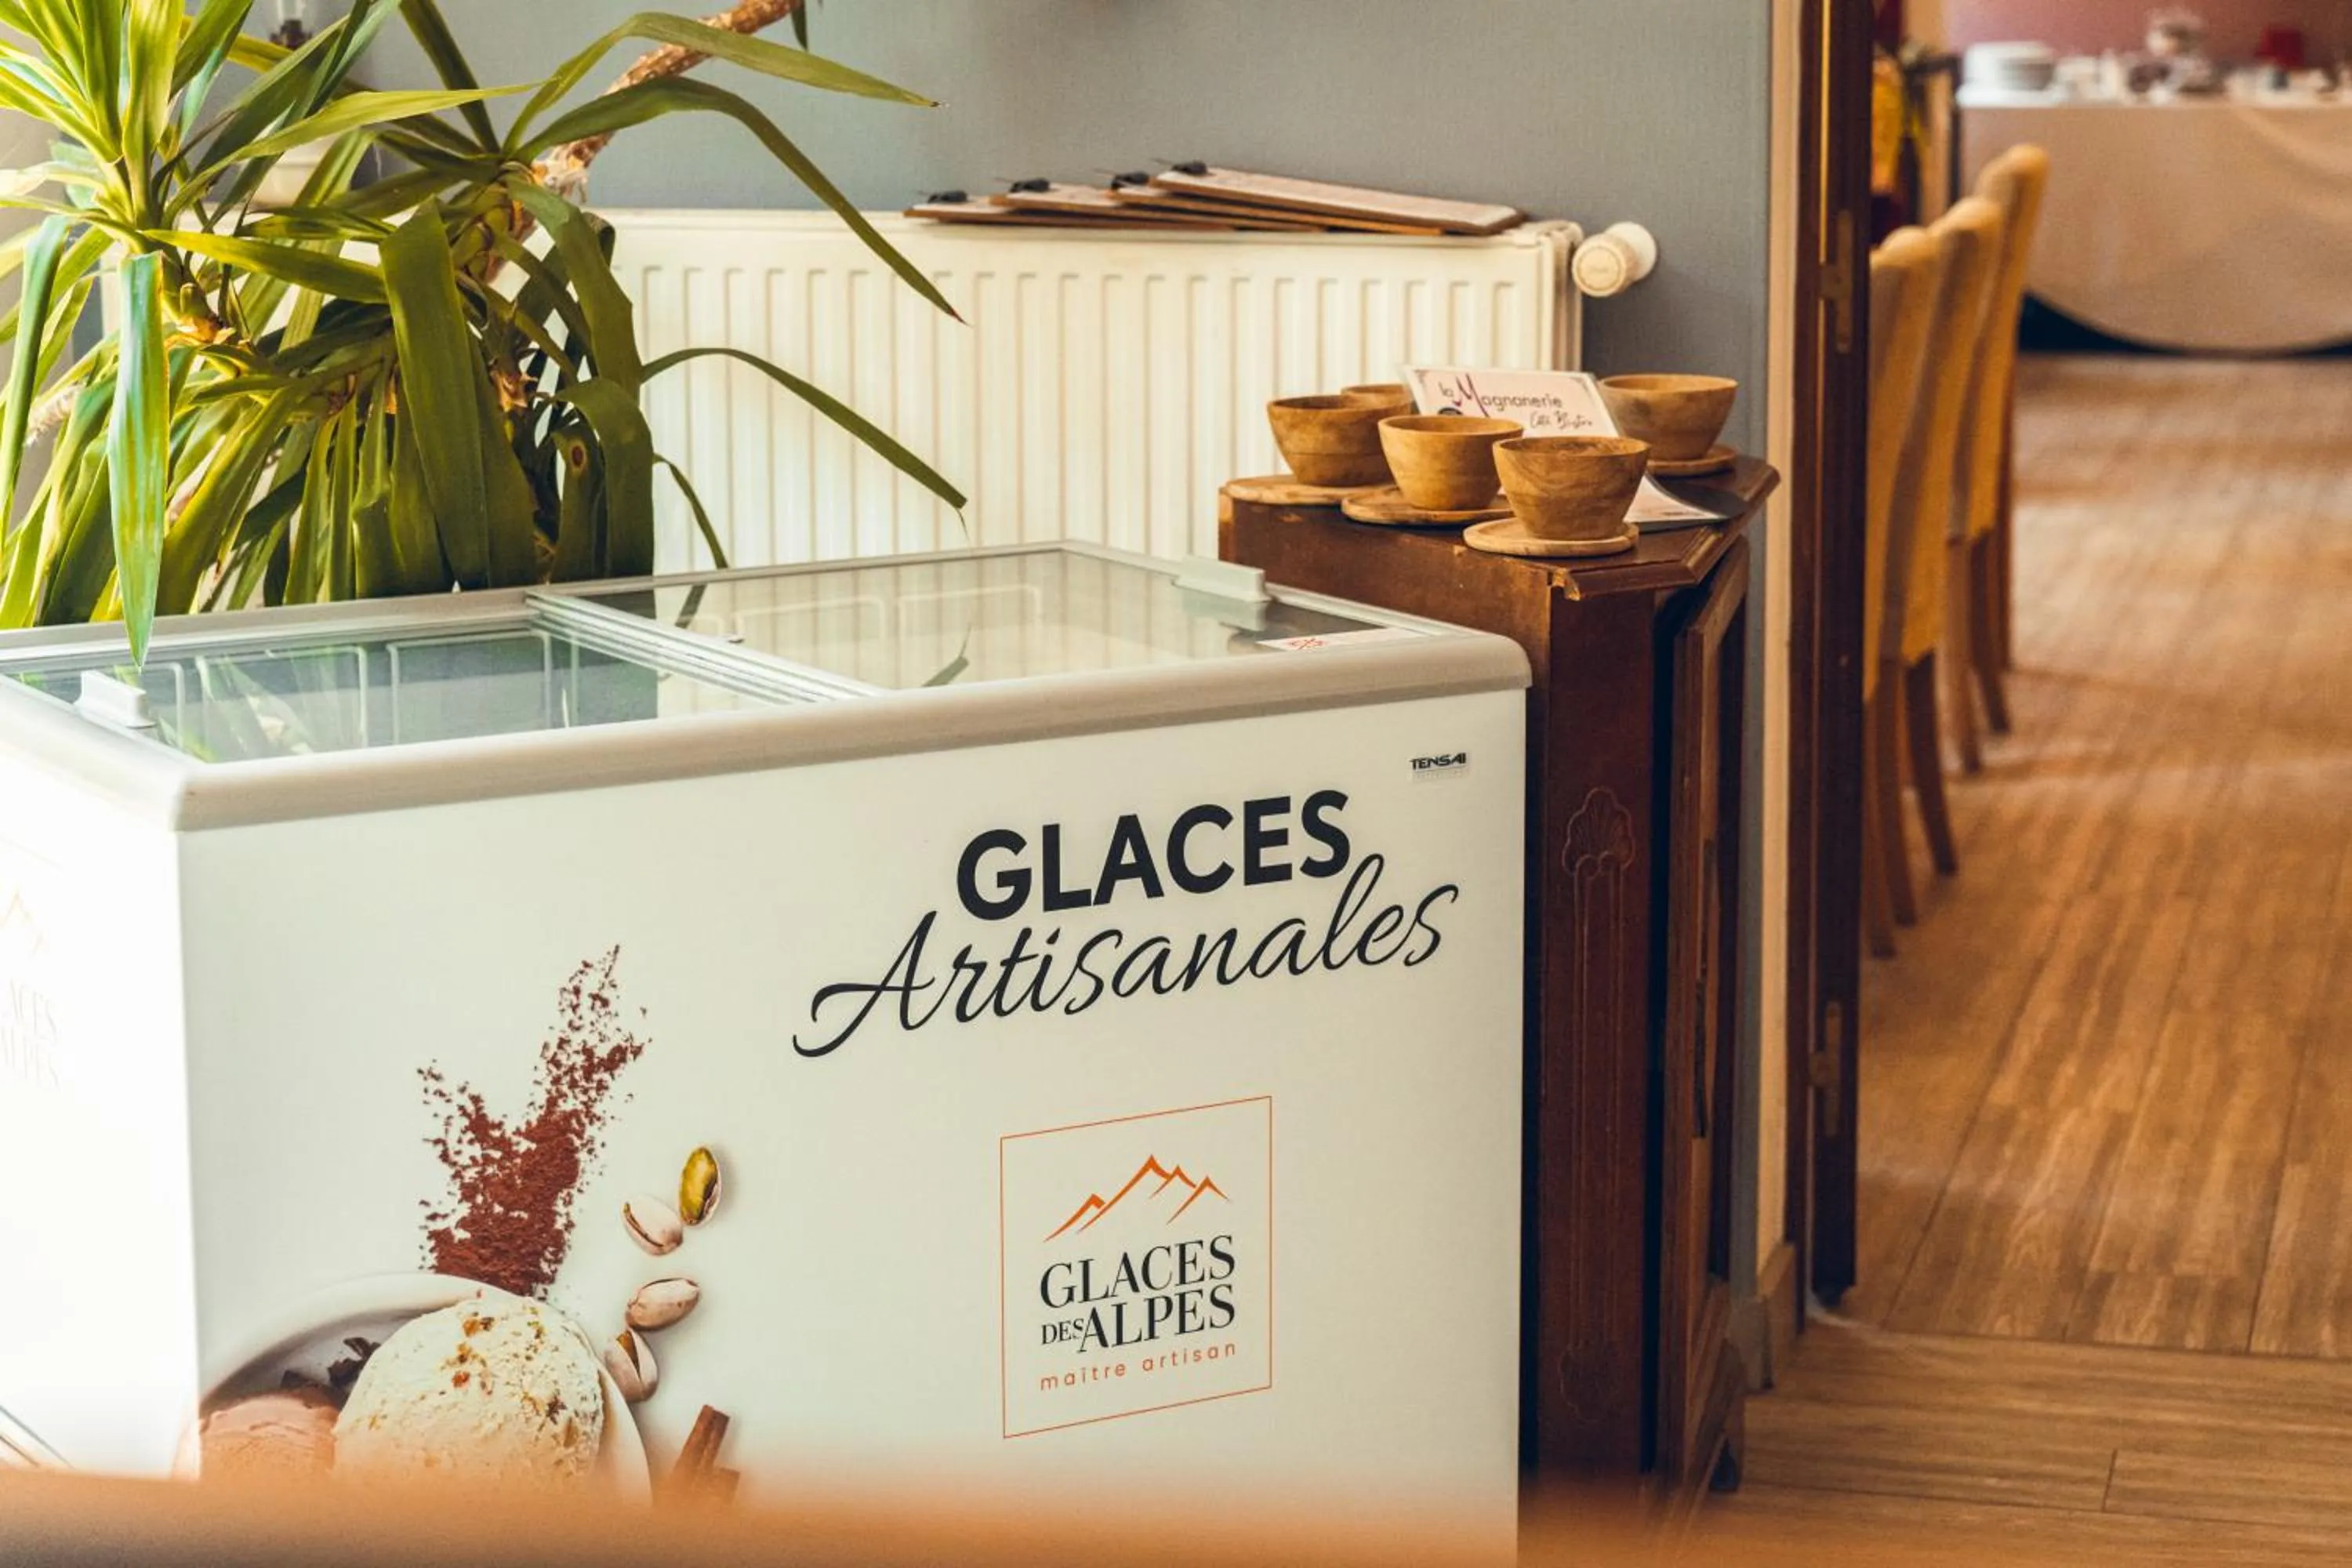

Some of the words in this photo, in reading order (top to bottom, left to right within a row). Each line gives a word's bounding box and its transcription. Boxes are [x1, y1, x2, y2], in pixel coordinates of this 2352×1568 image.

[1453, 372, 1563, 417] Magnanerie
[1409, 752, 1467, 771] TENSAI
[956, 789, 1352, 921] GLACES
[792, 853, 1460, 1058] Artisanales
[1040, 1234, 1236, 1308] GLACES
[1040, 1317, 1085, 1346] DES
[1076, 1283, 1236, 1354] ALPES
[1142, 1342, 1236, 1373] artisan
